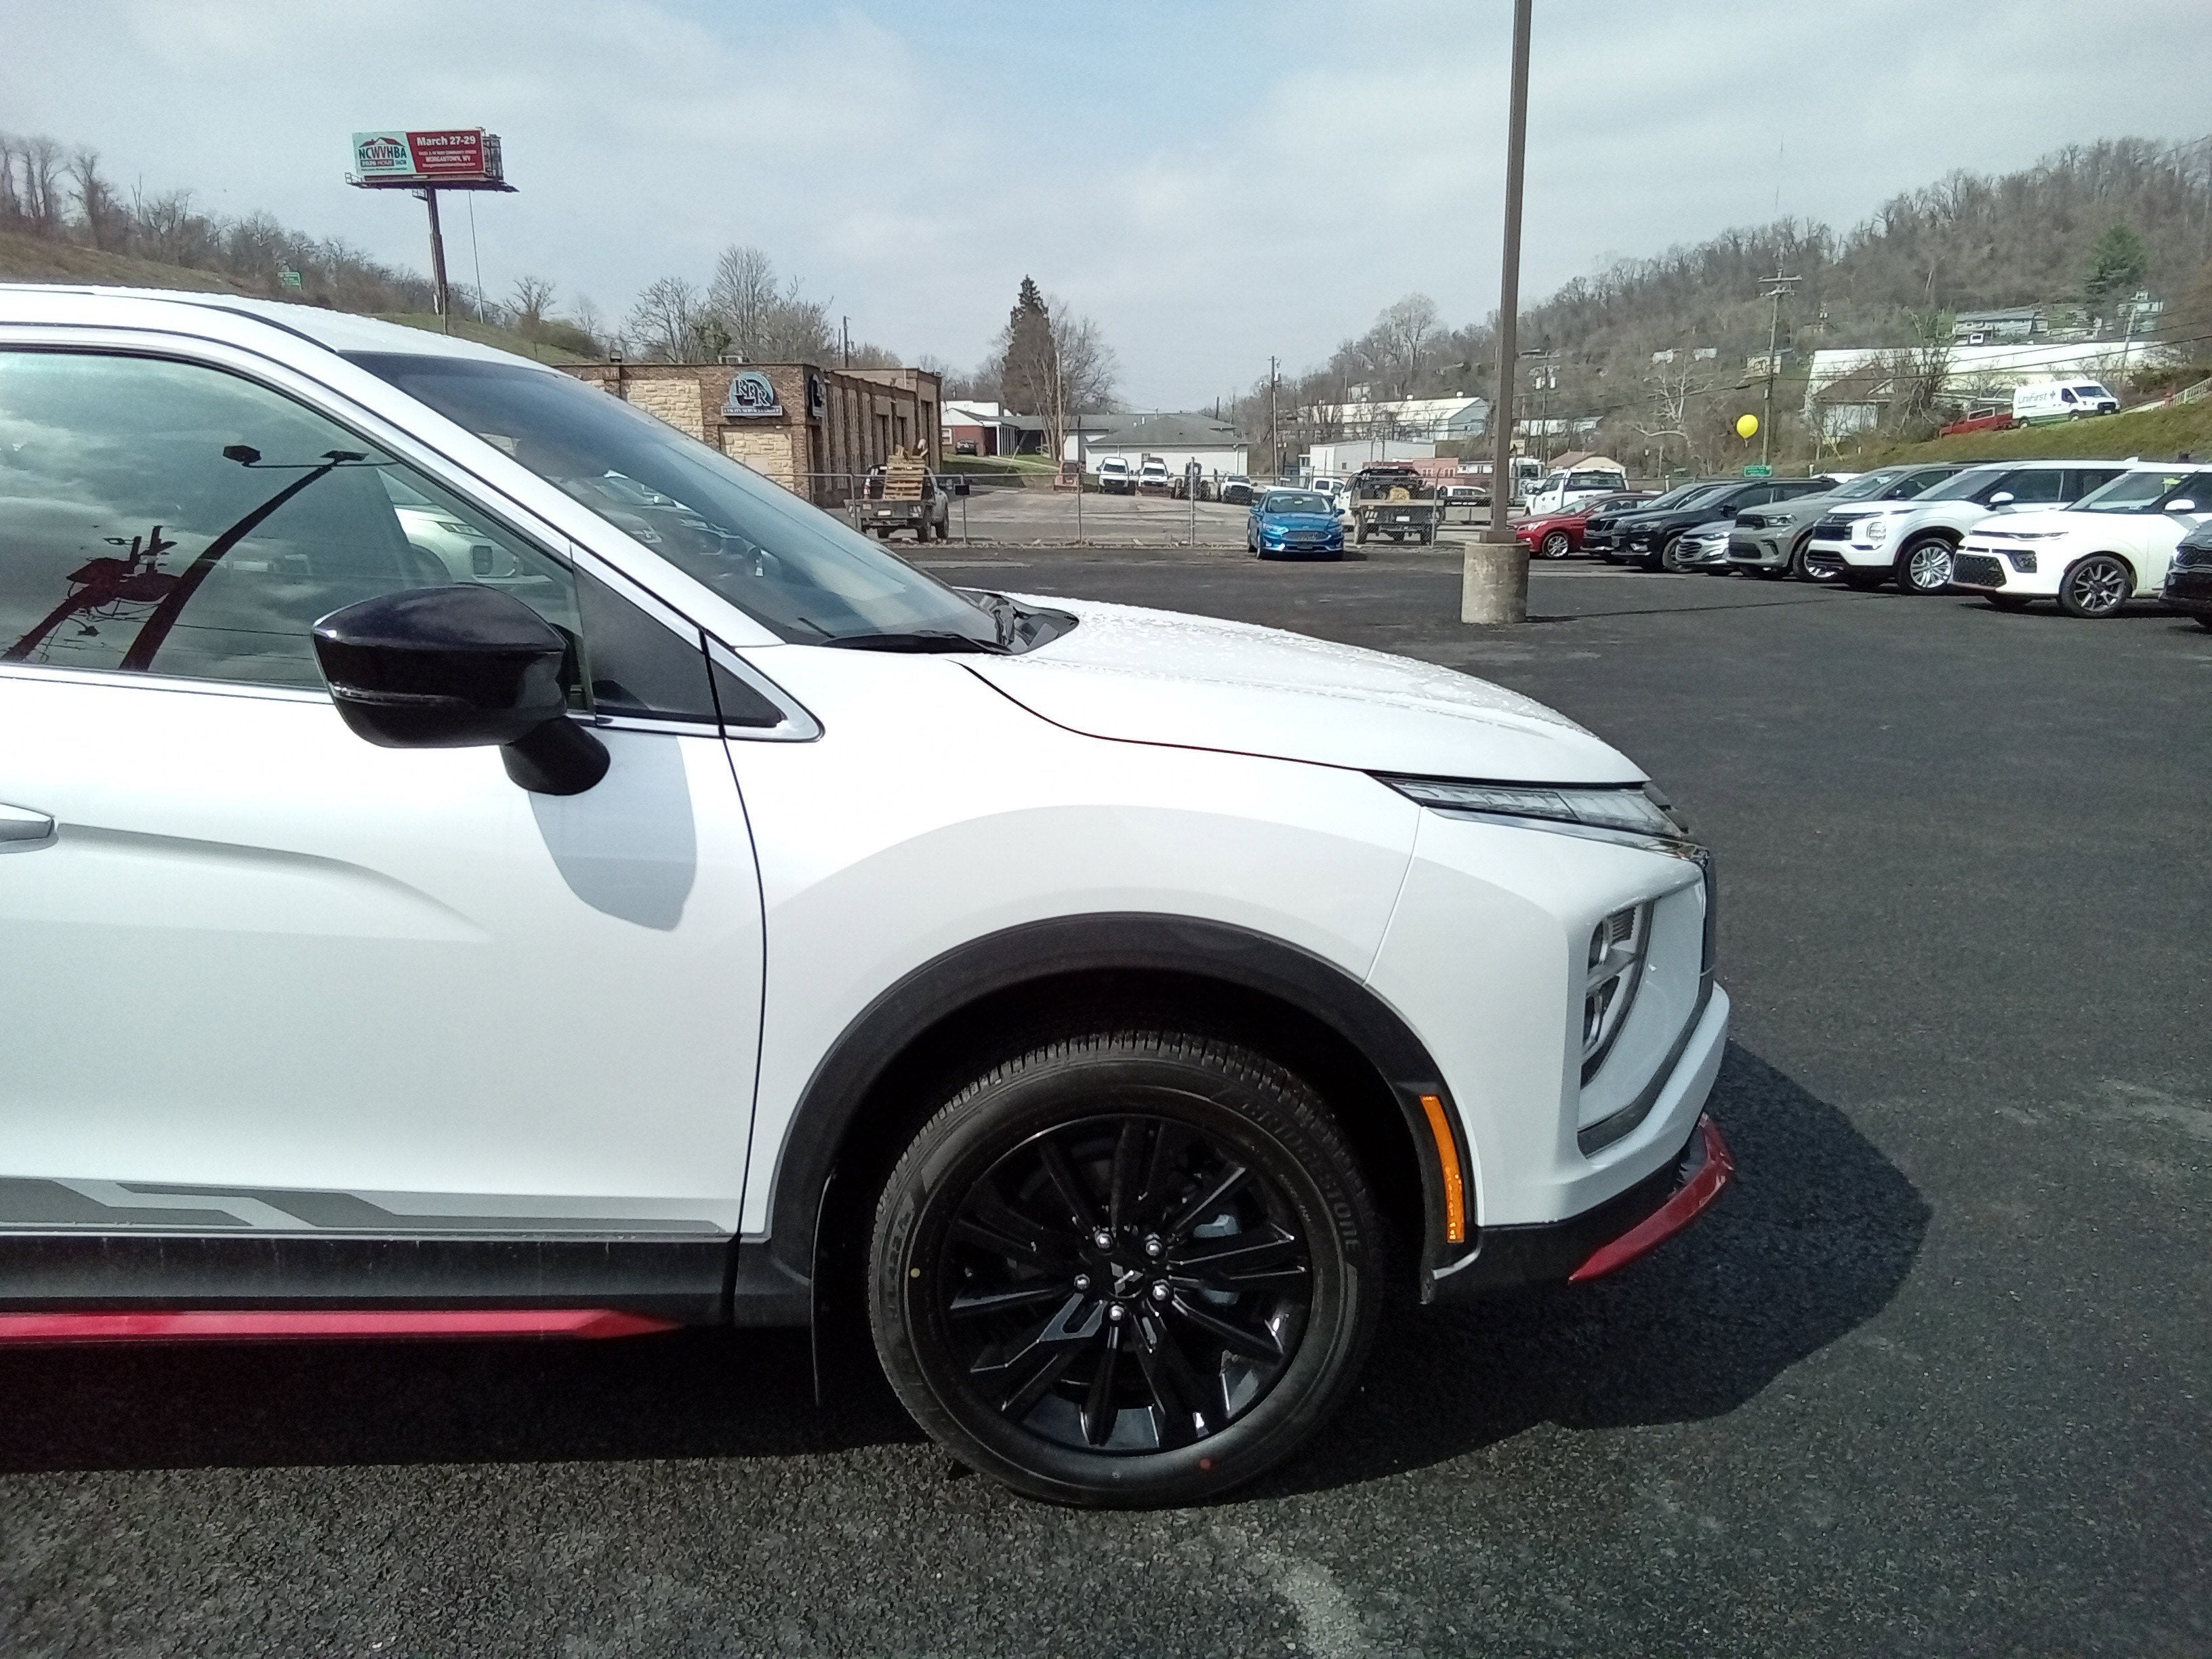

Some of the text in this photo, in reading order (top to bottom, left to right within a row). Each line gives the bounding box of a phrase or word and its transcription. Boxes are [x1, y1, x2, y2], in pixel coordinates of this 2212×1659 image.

[417, 136, 476, 146] March 27-29
[359, 146, 407, 159] NCWVHBA
[2019, 392, 2047, 404] UniFirst
